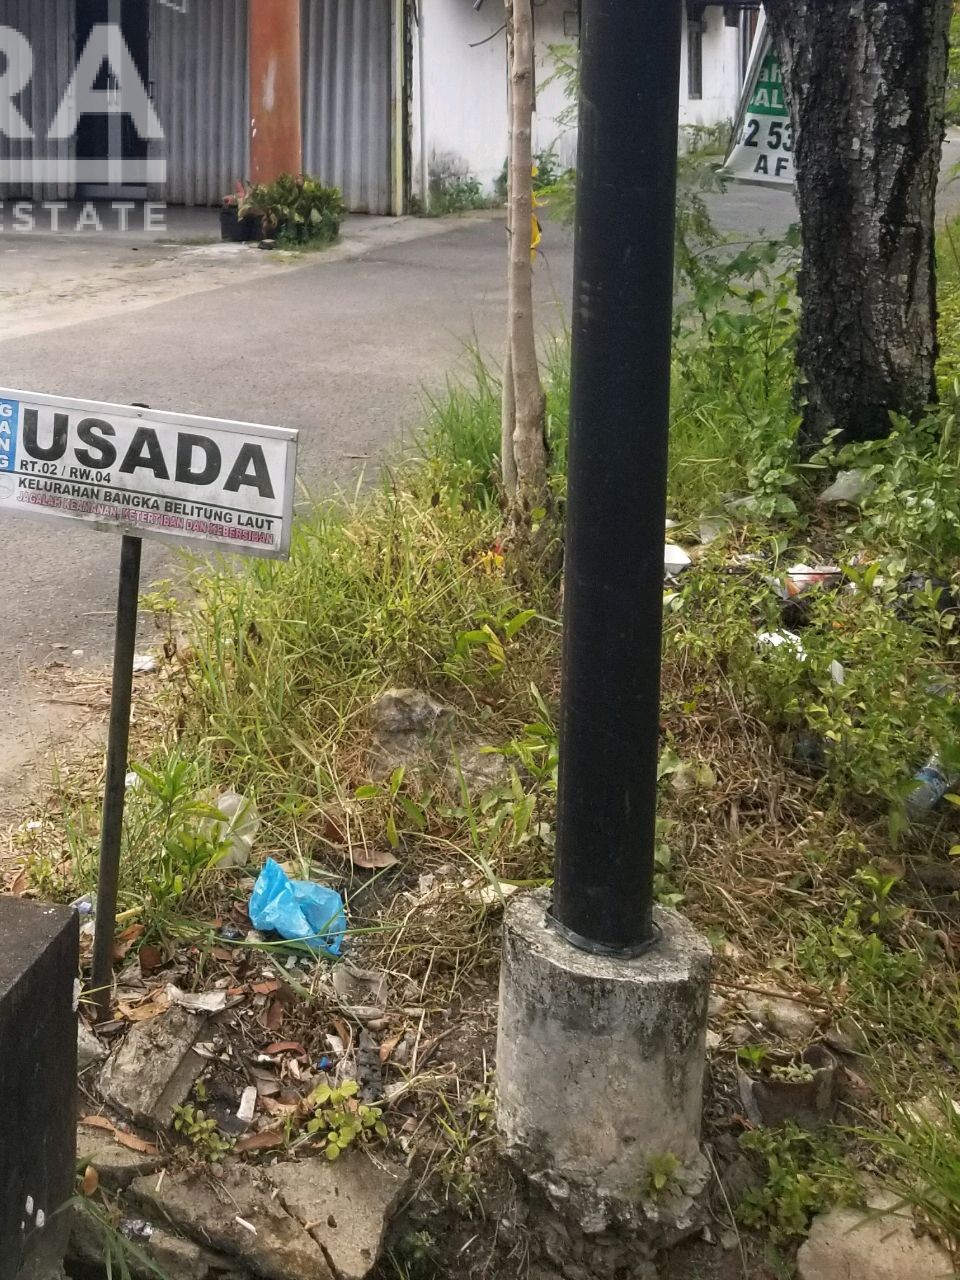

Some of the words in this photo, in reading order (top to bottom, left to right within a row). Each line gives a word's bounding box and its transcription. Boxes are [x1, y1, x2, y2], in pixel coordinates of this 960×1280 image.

[20, 459, 58, 475] RT.02
[69, 466, 112, 484] RW.04
[22, 407, 276, 500] USADA
[18, 477, 100, 500] KELURAHAN
[103, 490, 160, 511] BANGKA
[164, 500, 233, 524] BELITUNG
[237, 515, 274, 531] LAUT
[122, 507, 184, 529] KETERTIBAN
[185, 519, 208, 534] DAN
[207, 522, 274, 545] KEBERSIHAN
